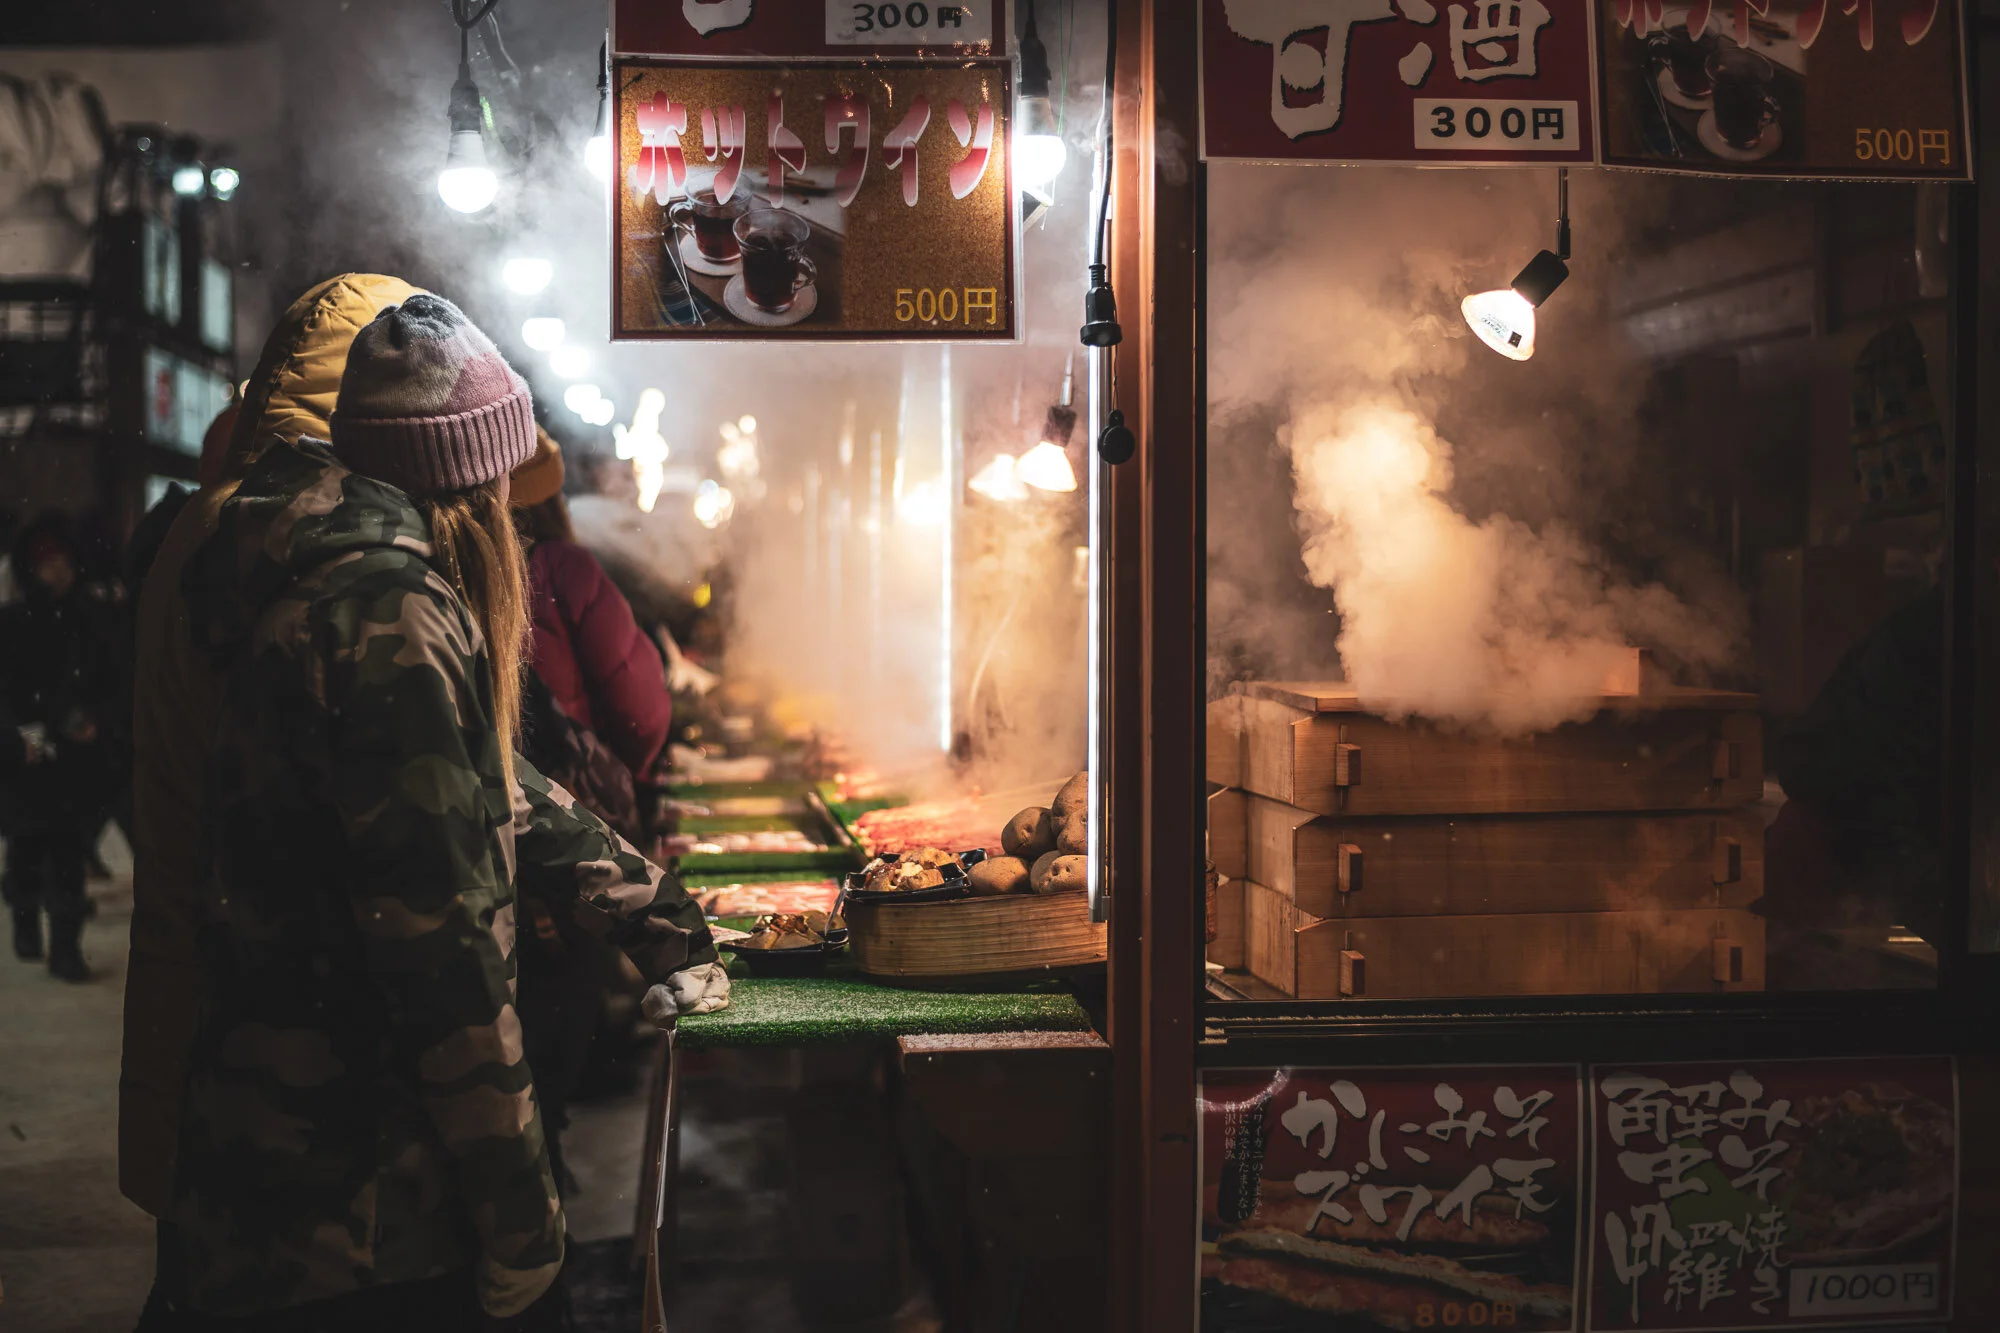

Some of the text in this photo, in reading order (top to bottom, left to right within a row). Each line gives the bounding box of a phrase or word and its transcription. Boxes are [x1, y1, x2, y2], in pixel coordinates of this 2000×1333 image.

[853, 2, 962, 33] 300円
[1430, 106, 1564, 140] 300円
[636, 91, 995, 208] ホットワイン
[1854, 128, 1950, 165] 500円
[894, 286, 998, 325] 500円
[1280, 1080, 1555, 1171] かにみそ
[1806, 1272, 1935, 1304] 1000円
[1414, 1300, 1517, 1328] 800円
